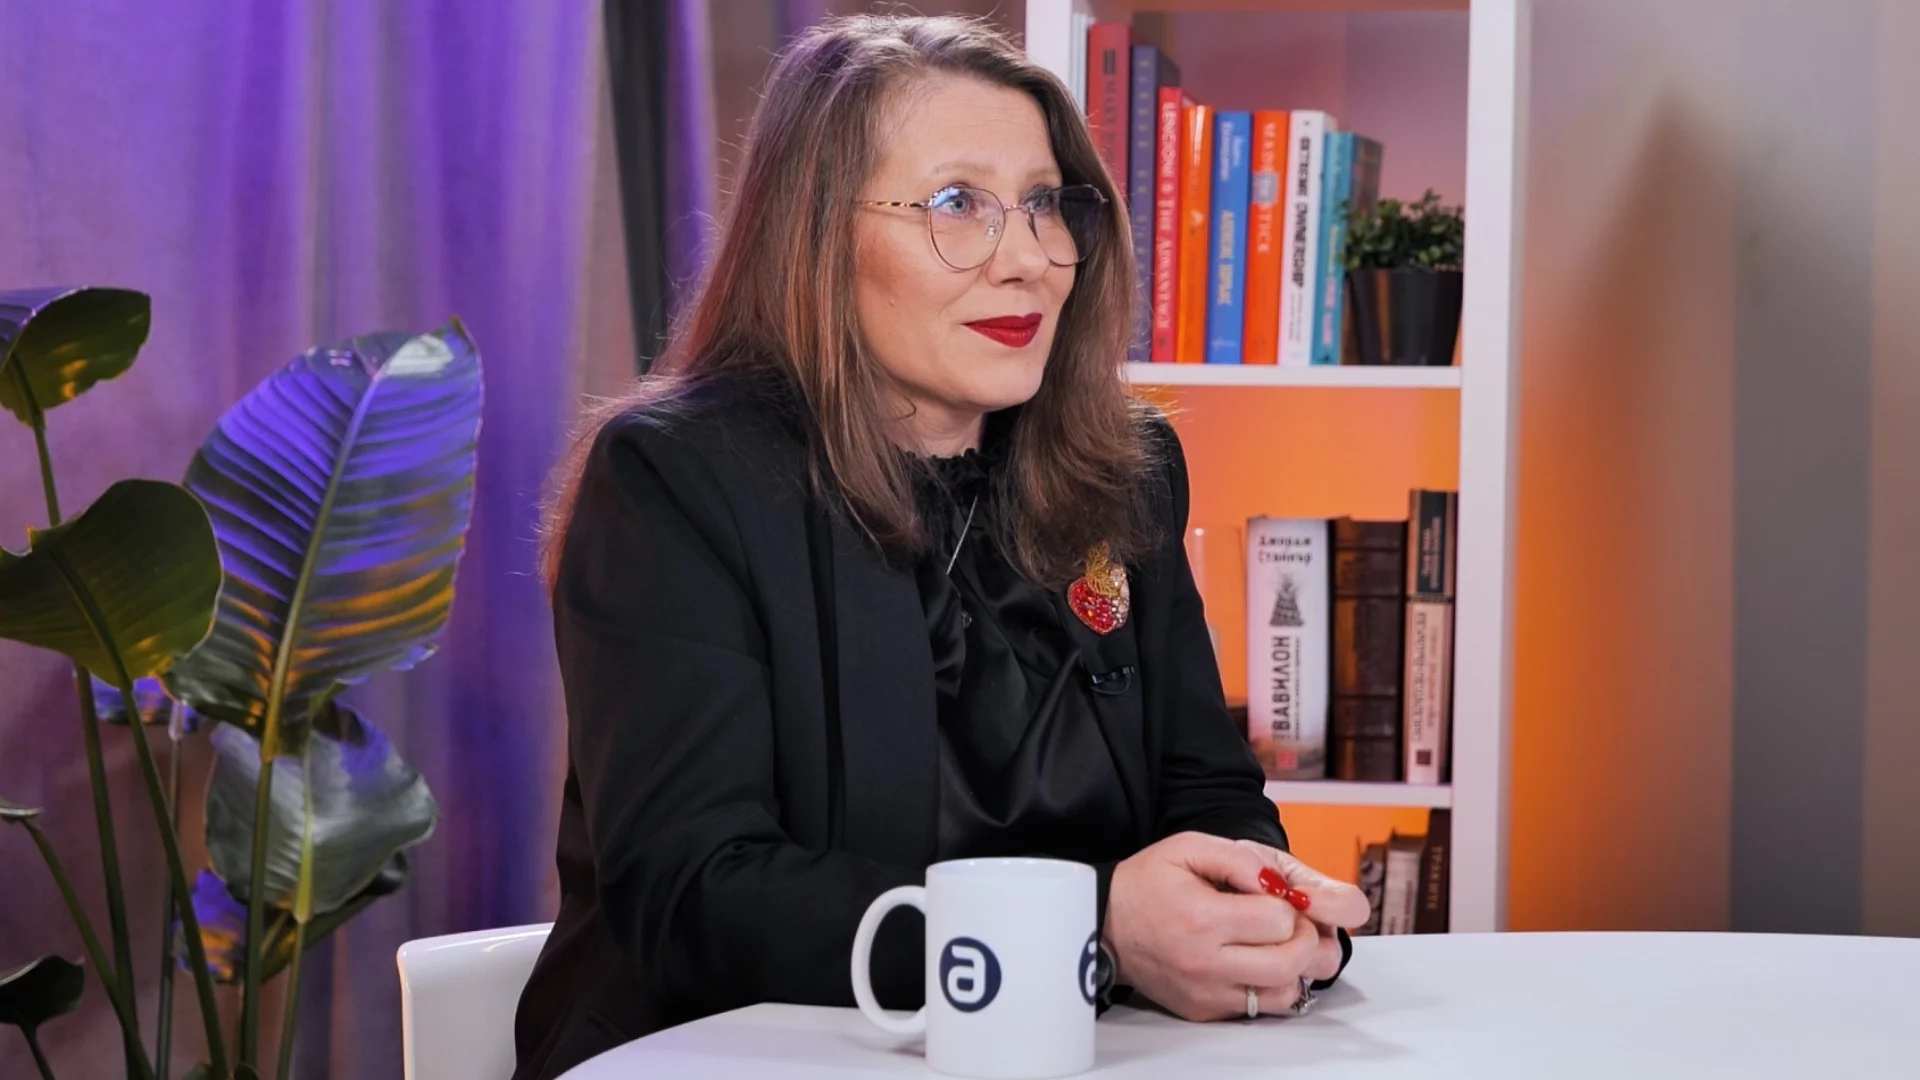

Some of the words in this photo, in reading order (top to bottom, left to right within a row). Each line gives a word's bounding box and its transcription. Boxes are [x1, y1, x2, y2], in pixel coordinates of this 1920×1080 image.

[1162, 102, 1177, 177] LENCIONI
[1261, 121, 1277, 172] MADE
[1297, 137, 1311, 197] EXTREME
[1257, 202, 1274, 253] STICK
[1291, 203, 1309, 287] OWNERSHIP
[1153, 239, 1173, 329] ADVANTAGE
[1271, 636, 1292, 731] ВАВИЛОН
